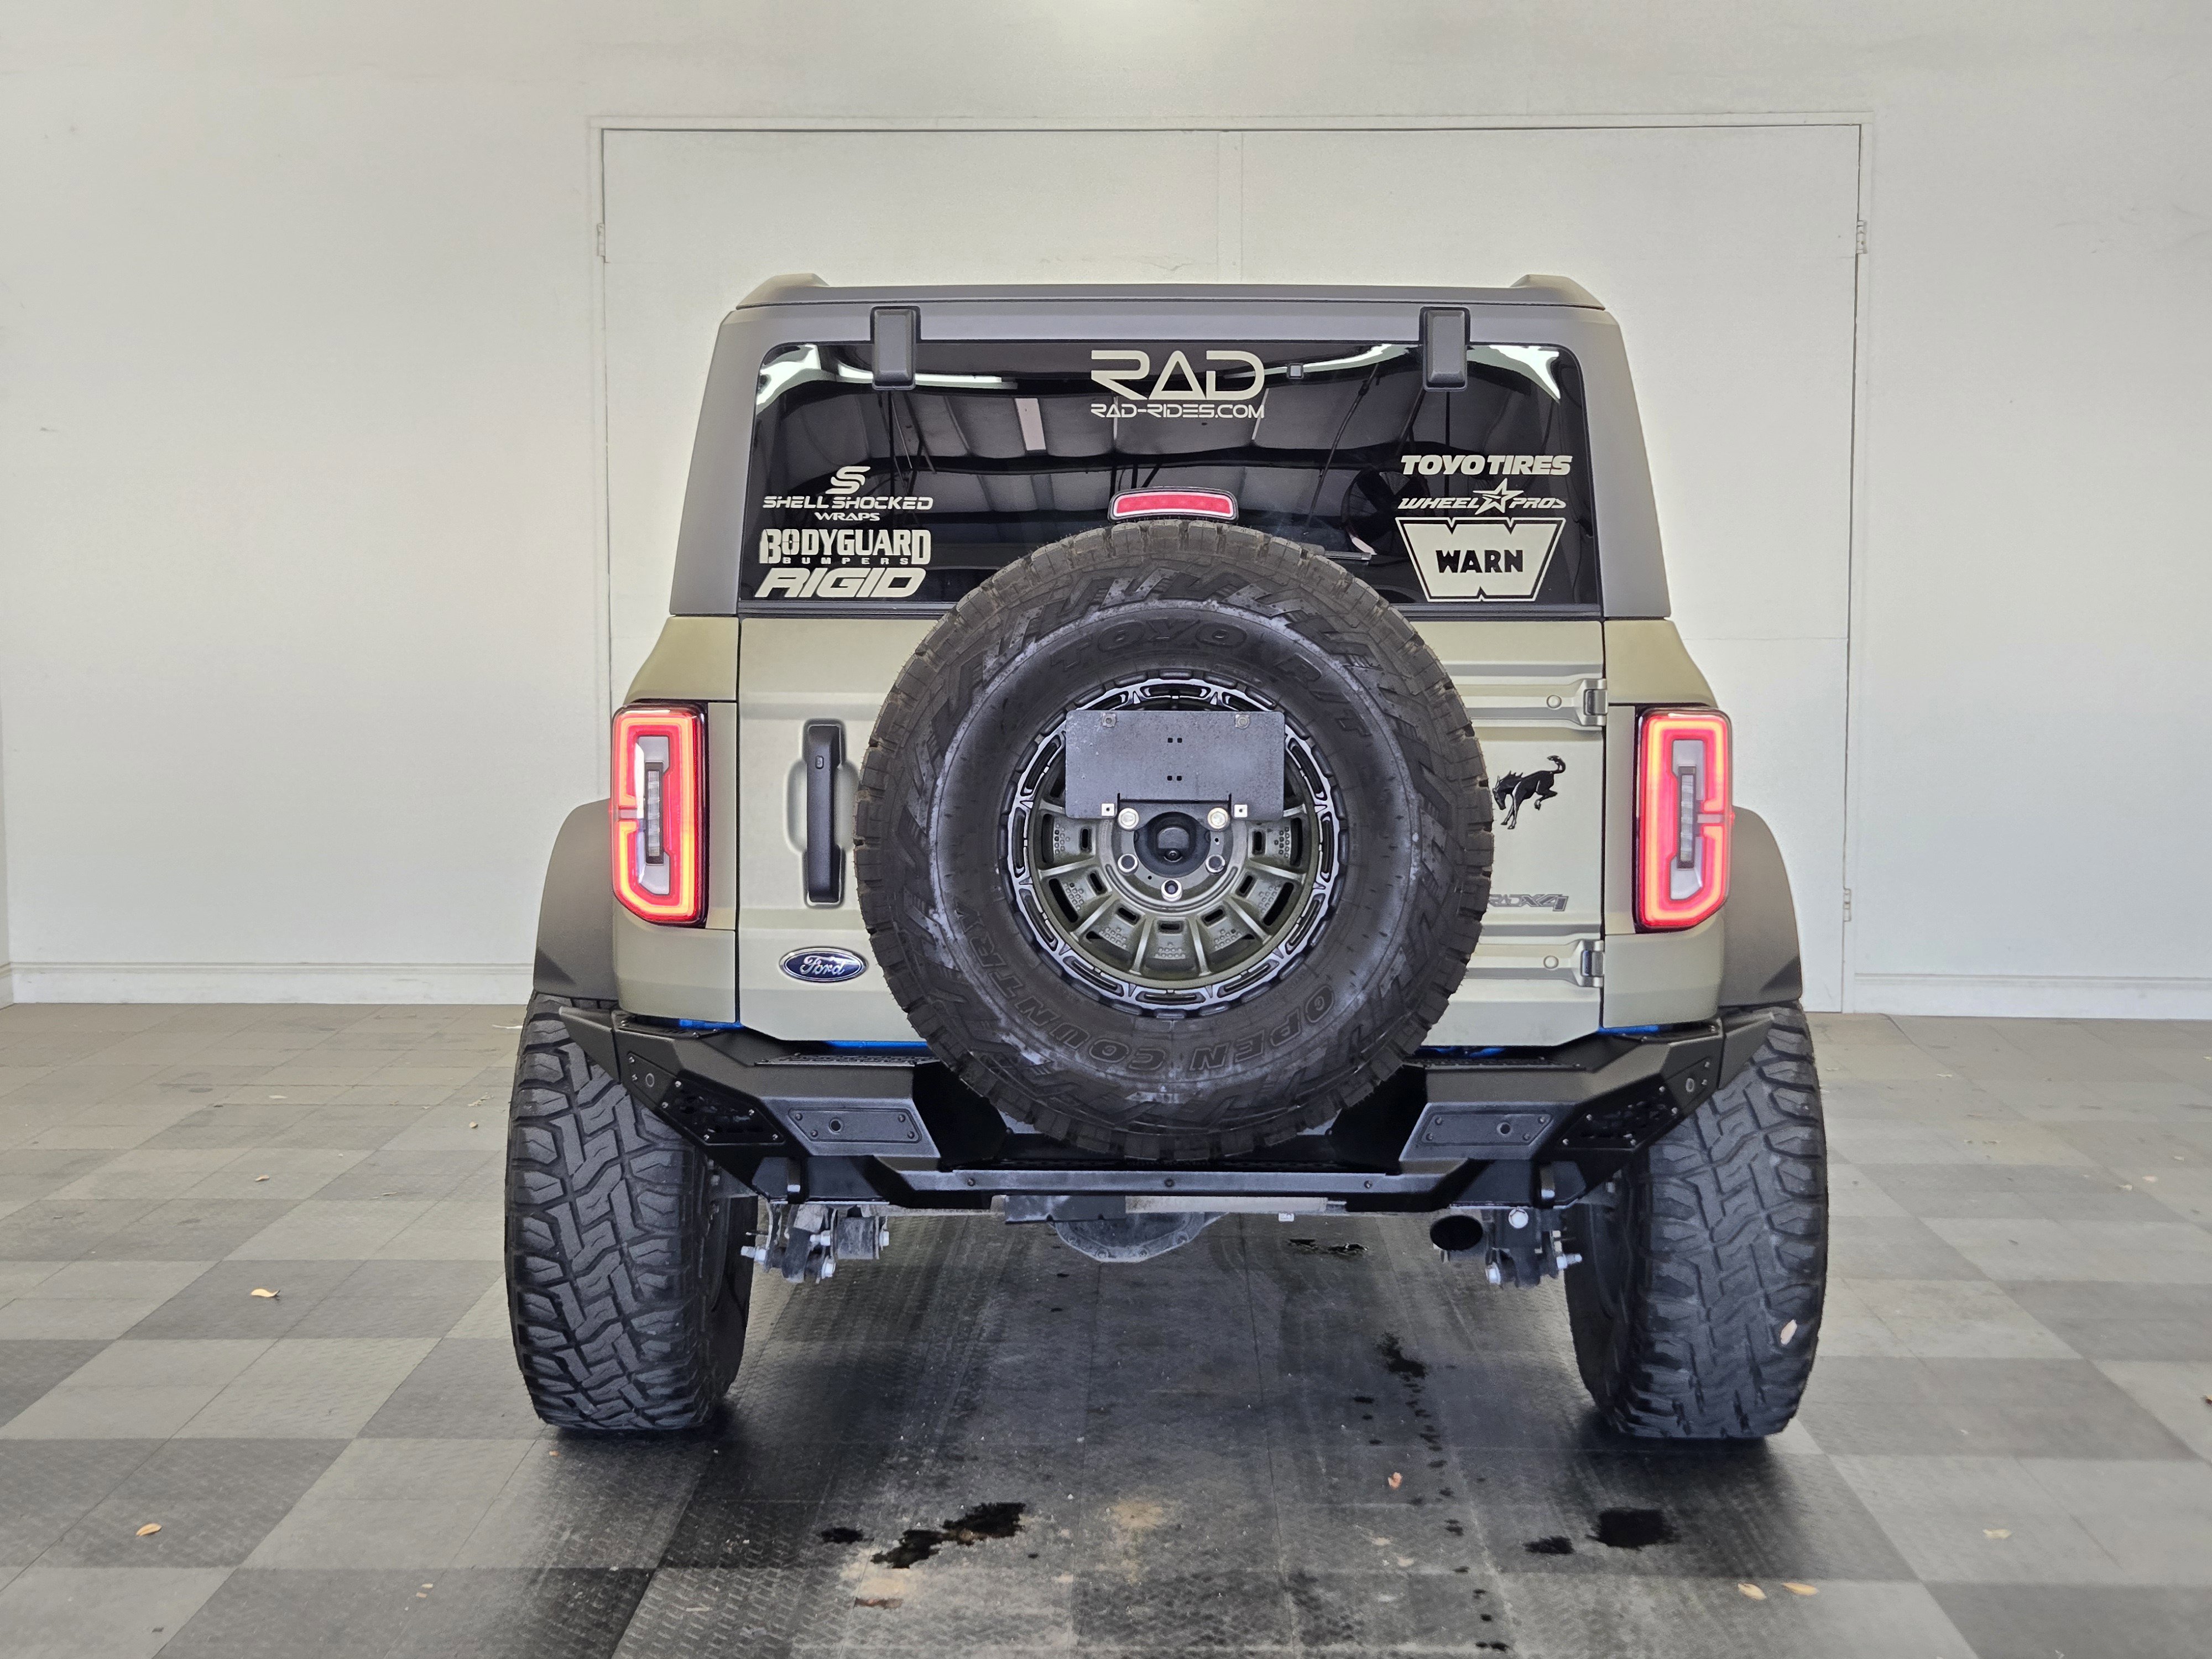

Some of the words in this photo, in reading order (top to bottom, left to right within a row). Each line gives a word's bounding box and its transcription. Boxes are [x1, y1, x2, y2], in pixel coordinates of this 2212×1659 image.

[1091, 350, 1265, 400] RAD
[1091, 404, 1265, 419] RAD-RIDES.COM
[1401, 455, 1486, 475] TOYO
[1487, 455, 1573, 475] TIRES
[763, 496, 829, 509] SHELL
[831, 497, 933, 510] SHOCKED
[1397, 498, 1480, 509] WHEEL
[1509, 498, 1567, 509] PROS
[815, 512, 880, 520] WRAPS
[759, 529, 931, 564] BODYGUARD
[1435, 549, 1524, 573] WARN
[754, 568, 926, 597] RIGID
[1051, 618, 1247, 671] TOYO
[800, 956, 846, 975] Ford
[1189, 984, 1335, 1071] OPEN
